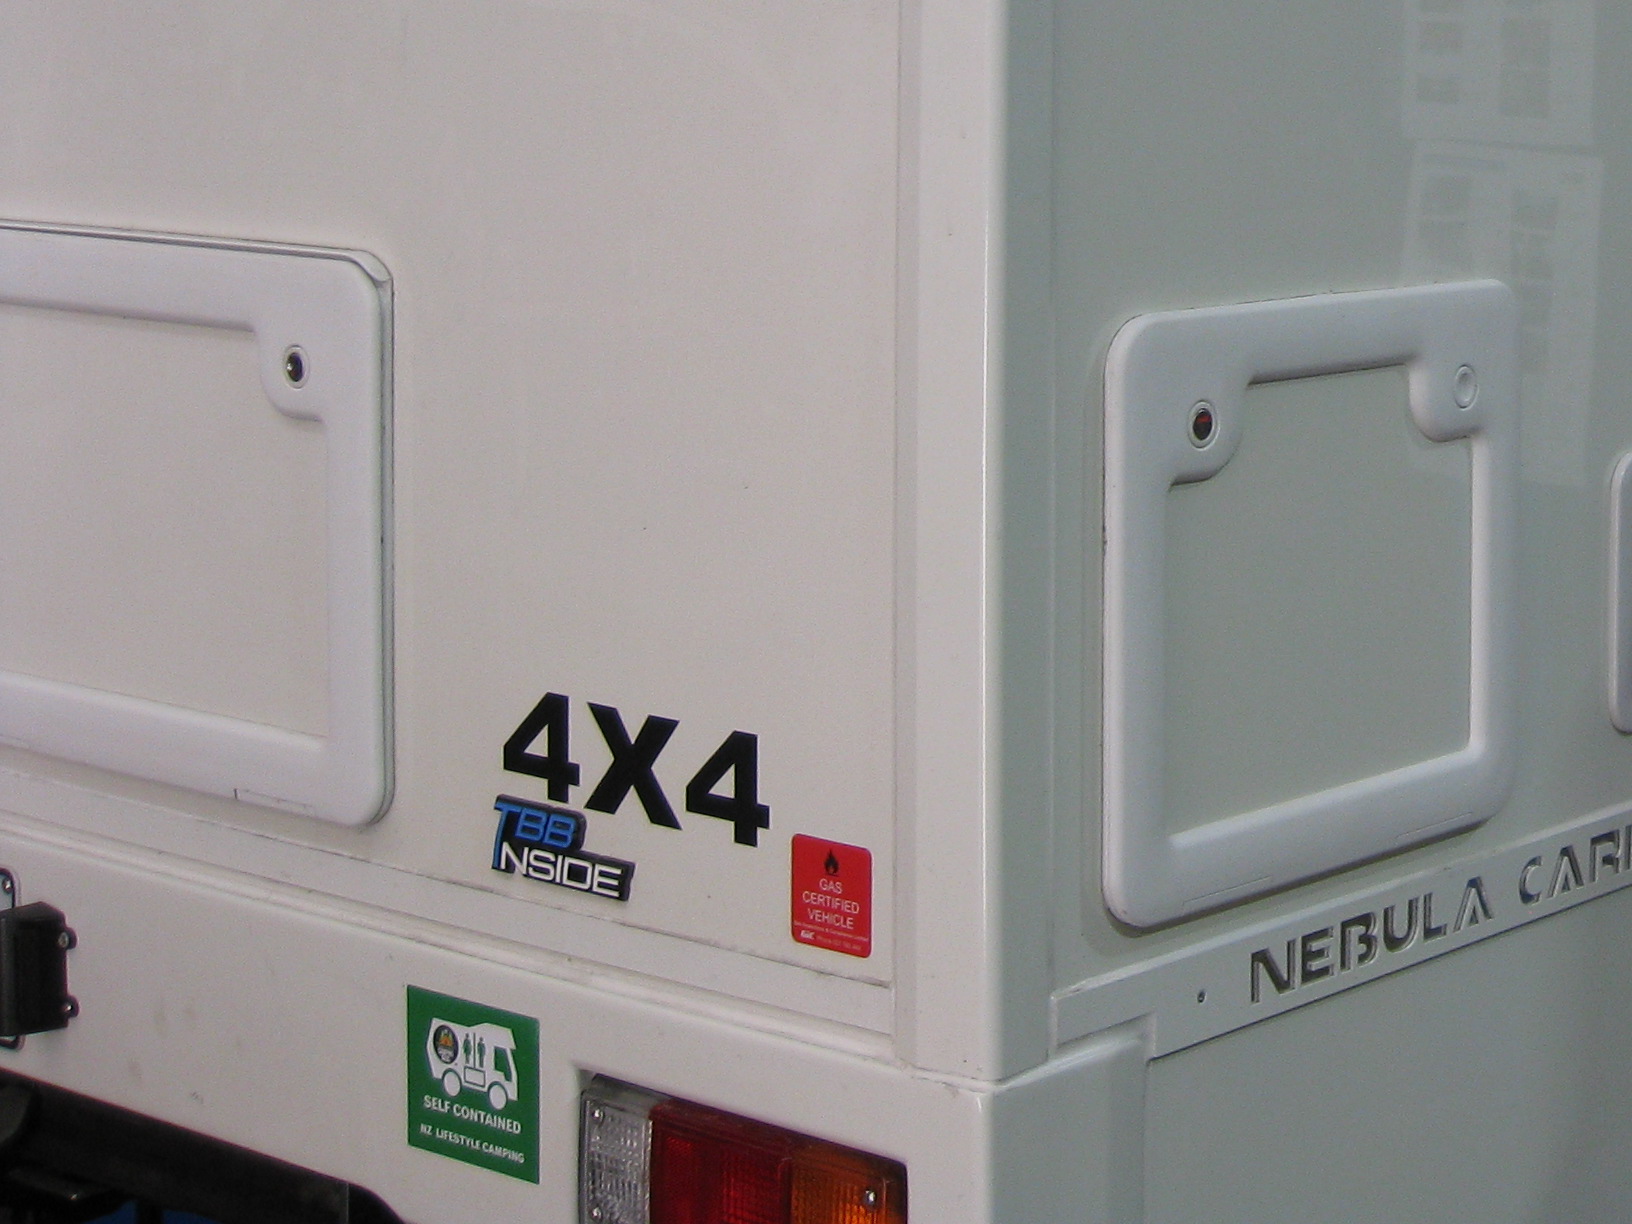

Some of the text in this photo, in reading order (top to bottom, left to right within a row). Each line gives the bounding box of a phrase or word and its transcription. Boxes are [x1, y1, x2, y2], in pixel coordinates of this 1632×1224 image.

[503, 692, 770, 847] 4X4
[493, 801, 576, 867] TBB
[802, 891, 859, 914] CERTIFIED
[819, 878, 842, 894] GAS
[808, 908, 853, 929] VEHICLE
[1250, 876, 1494, 1004] NEBULA
[424, 1095, 521, 1134] SELF CONTAINED
[420, 1124, 525, 1164] NZ LIFESTYLE CAMPING
